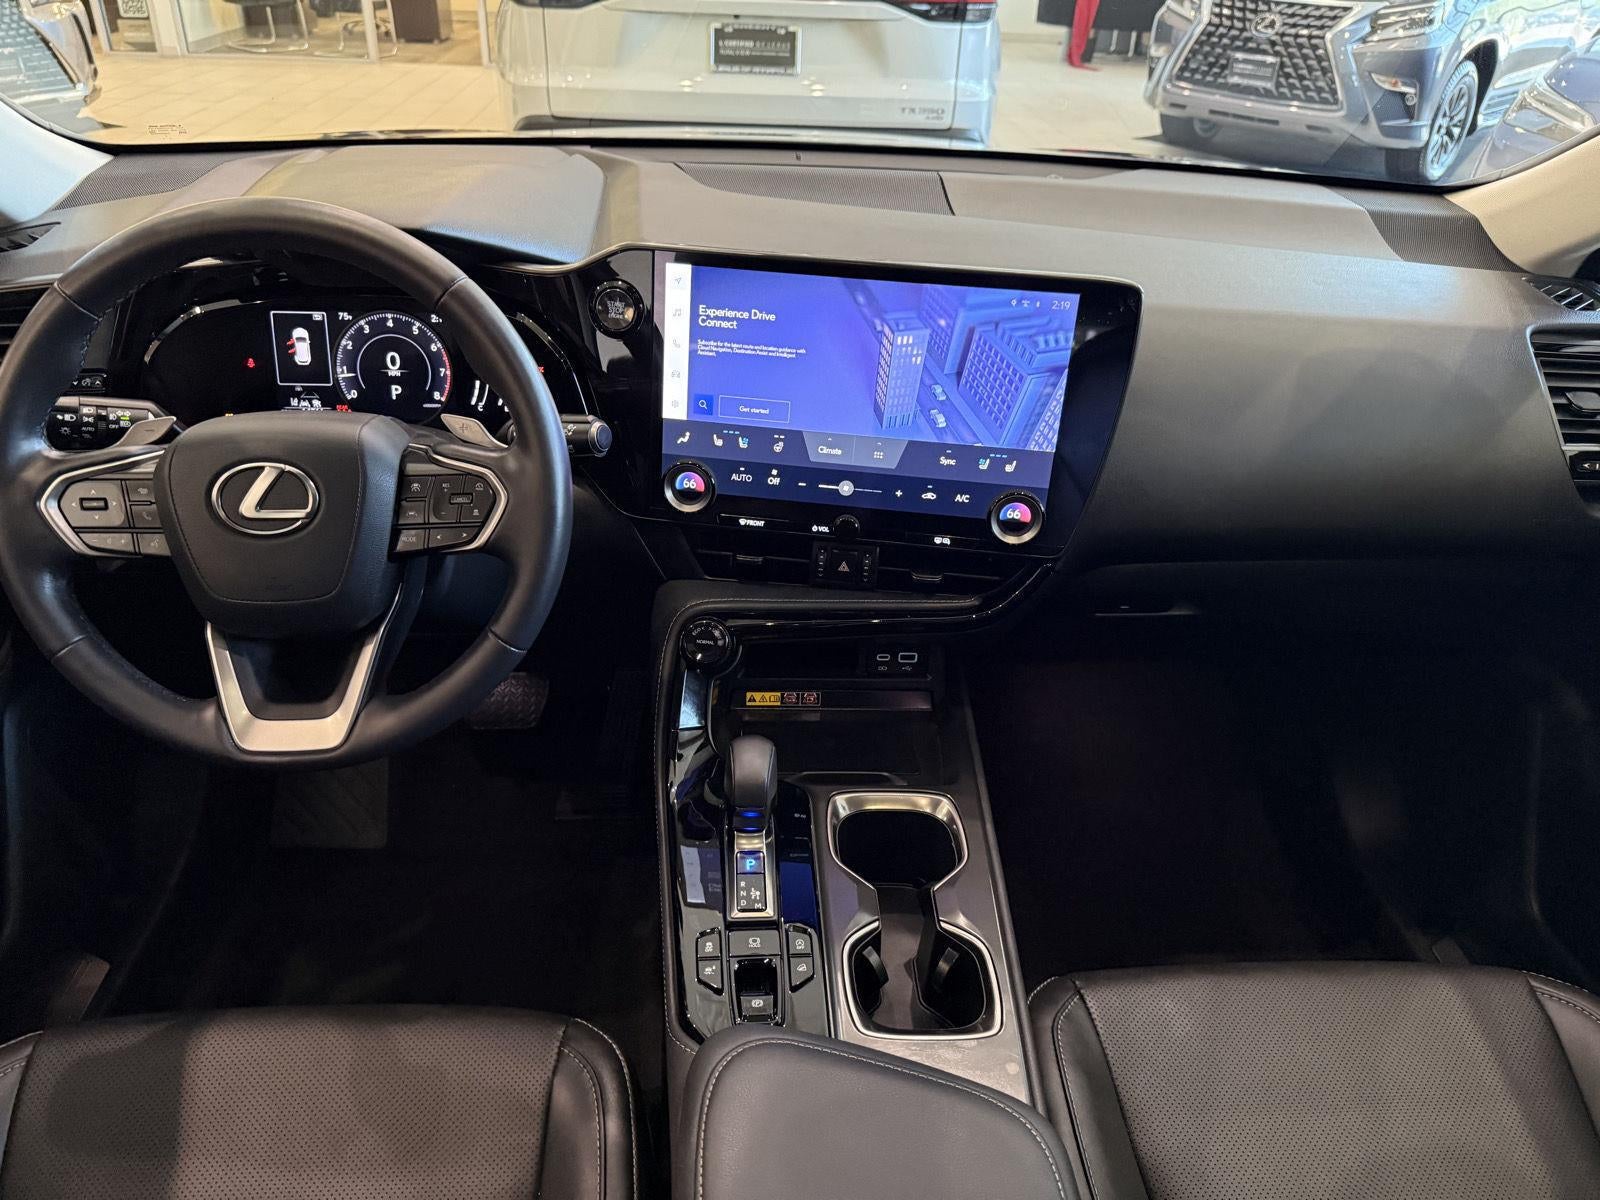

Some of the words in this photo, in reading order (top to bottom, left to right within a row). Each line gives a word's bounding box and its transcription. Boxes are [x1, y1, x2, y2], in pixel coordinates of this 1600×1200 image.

[1052, 300, 1071, 310] 2:19
[698, 304, 750, 318] Experience
[751, 309, 776, 322] Drive
[386, 319, 394, 328] 4
[698, 316, 738, 329] Connect
[363, 325, 370, 334] 3
[412, 326, 419, 335] 5
[346, 341, 353, 350] 2
[430, 343, 438, 352] 6
[386, 352, 401, 370] 0
[439, 368, 446, 376] 7
[350, 389, 358, 398] 0
[391, 385, 402, 400] P
[434, 391, 441, 400] 8
[739, 405, 750, 413] Get
[818, 446, 842, 455] Climate
[940, 456, 956, 468] Sync
[730, 473, 753, 482] AUTO
[768, 477, 780, 486] Off
[683, 478, 697, 489] 66
[955, 494, 970, 503] A/C
[1006, 508, 1022, 520] 66
[745, 858, 756, 871] P
